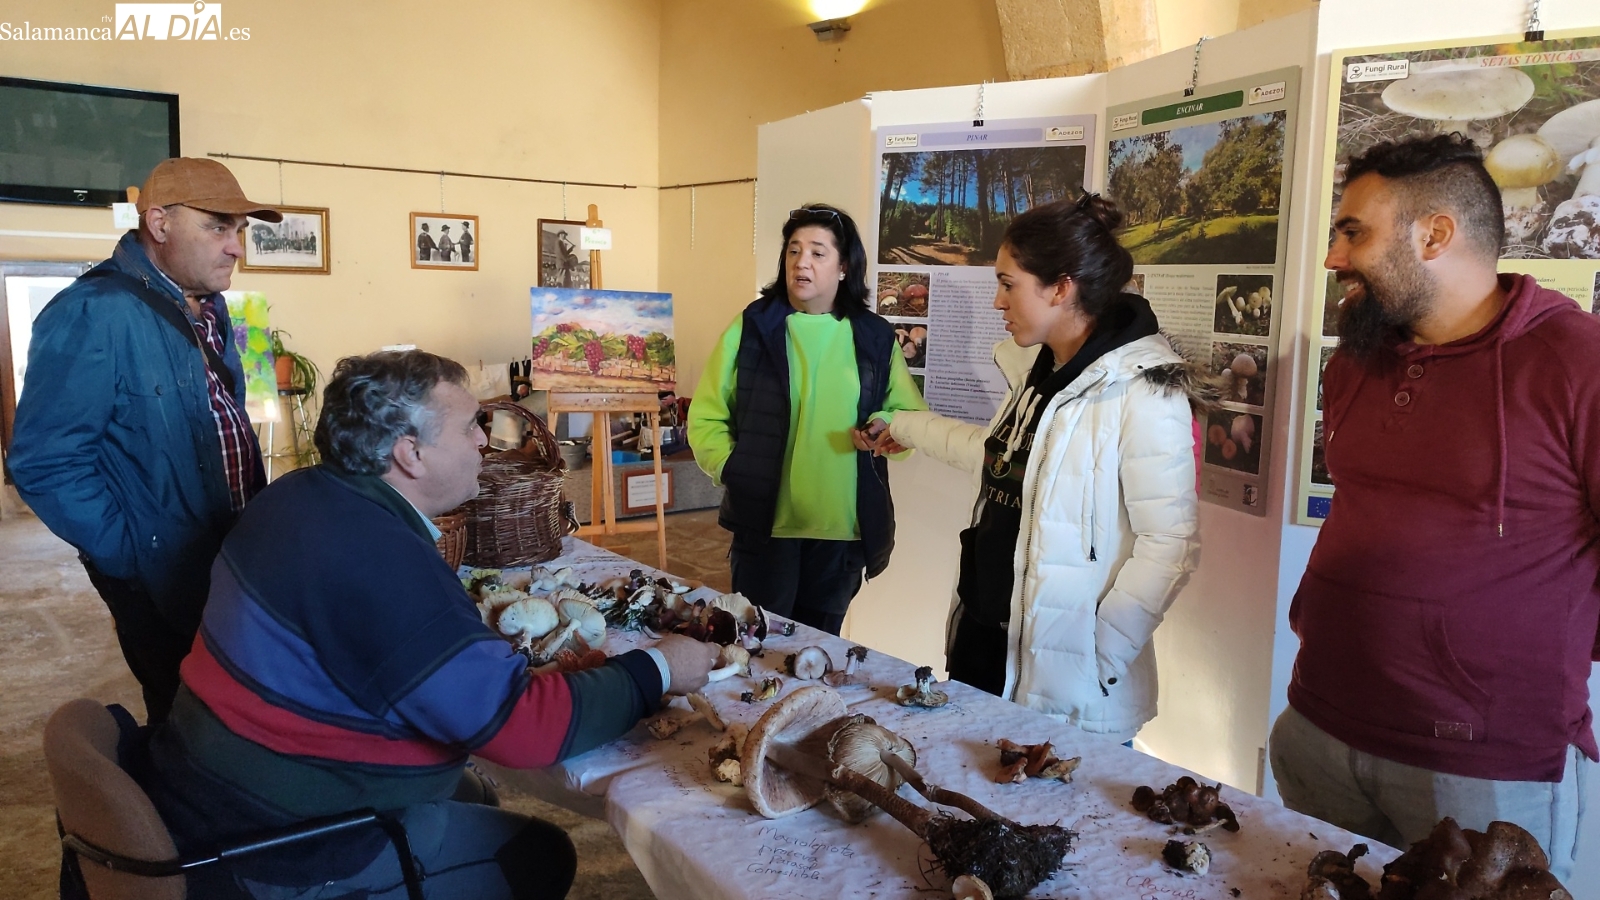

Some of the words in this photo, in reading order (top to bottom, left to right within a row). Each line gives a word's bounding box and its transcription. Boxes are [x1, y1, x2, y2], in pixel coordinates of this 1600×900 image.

[1480, 55, 1521, 67] SETAS
[1365, 65, 1386, 74] Fungi
[1387, 63, 1407, 71] Rural
[1176, 103, 1204, 115] ENCINAR
[966, 134, 988, 142] PINAR
